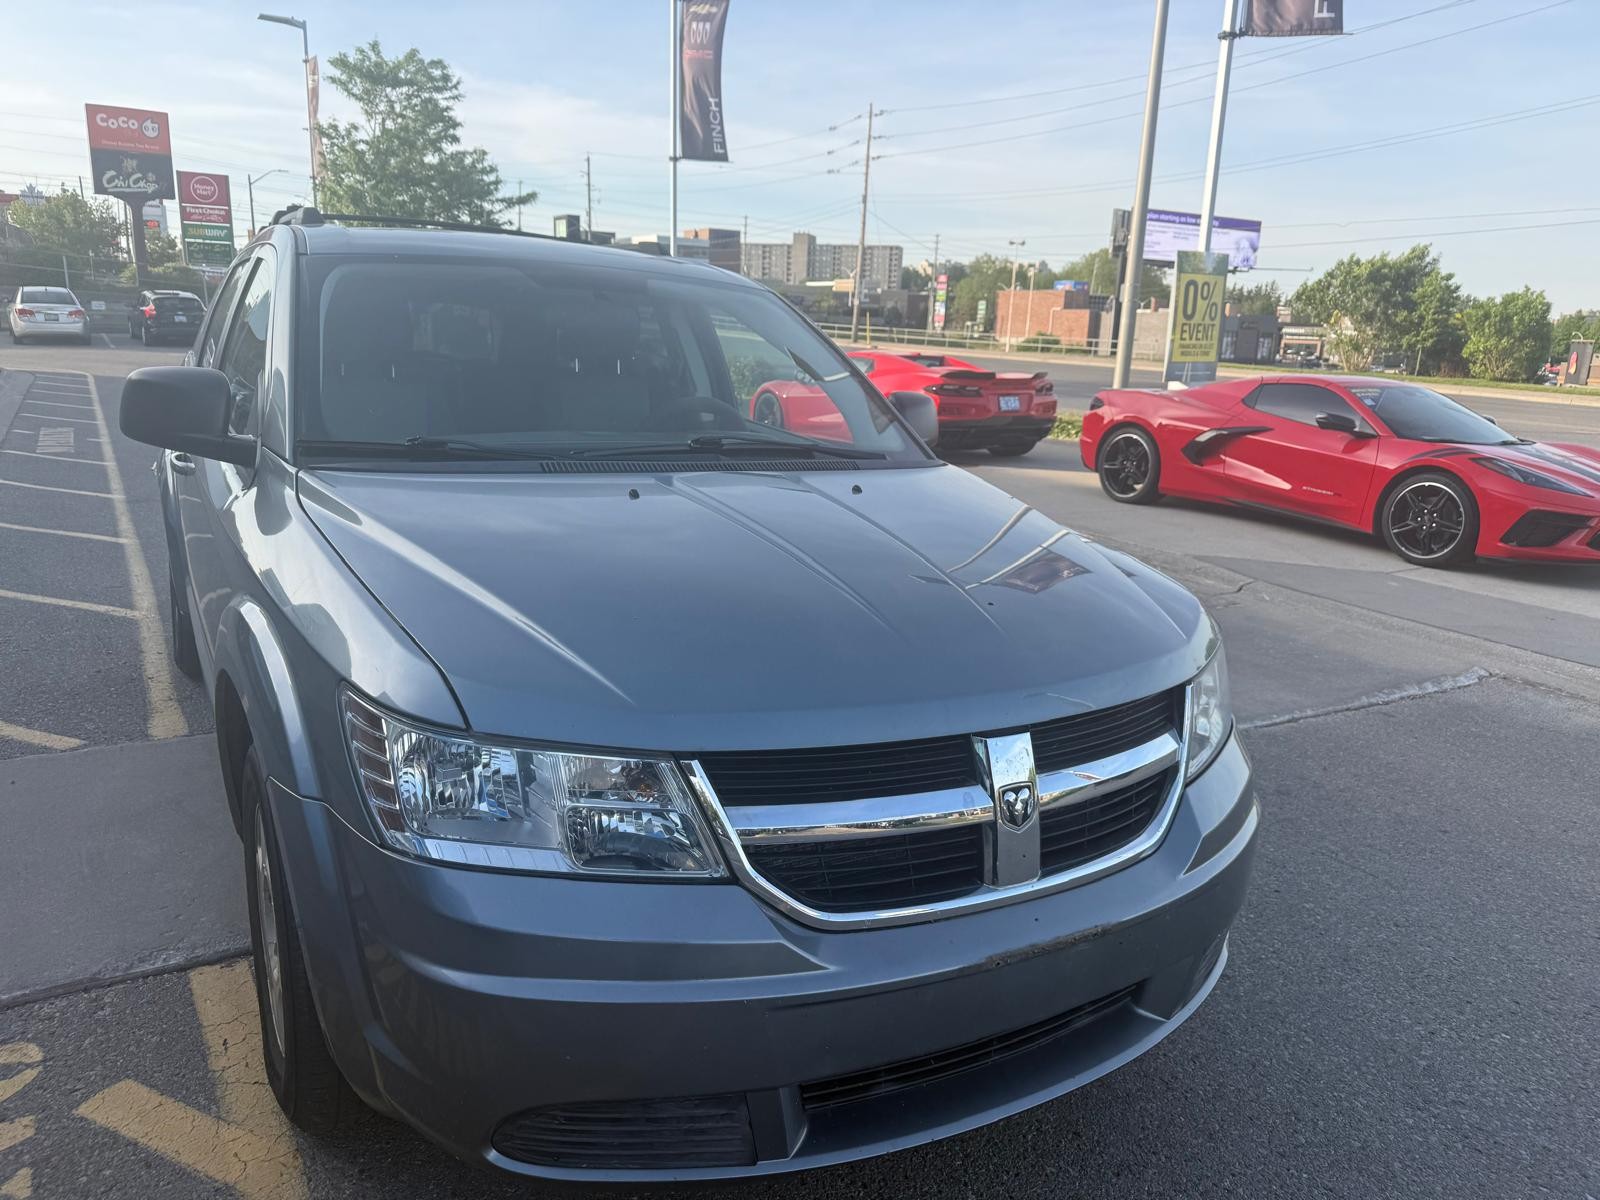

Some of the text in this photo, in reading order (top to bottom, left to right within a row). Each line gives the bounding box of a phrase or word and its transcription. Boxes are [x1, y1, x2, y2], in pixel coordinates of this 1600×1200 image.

[709, 98, 725, 154] FINCH
[187, 227, 226, 238] SUBWAY
[1182, 278, 1219, 322] 0%
[1180, 323, 1216, 341] EVENT
